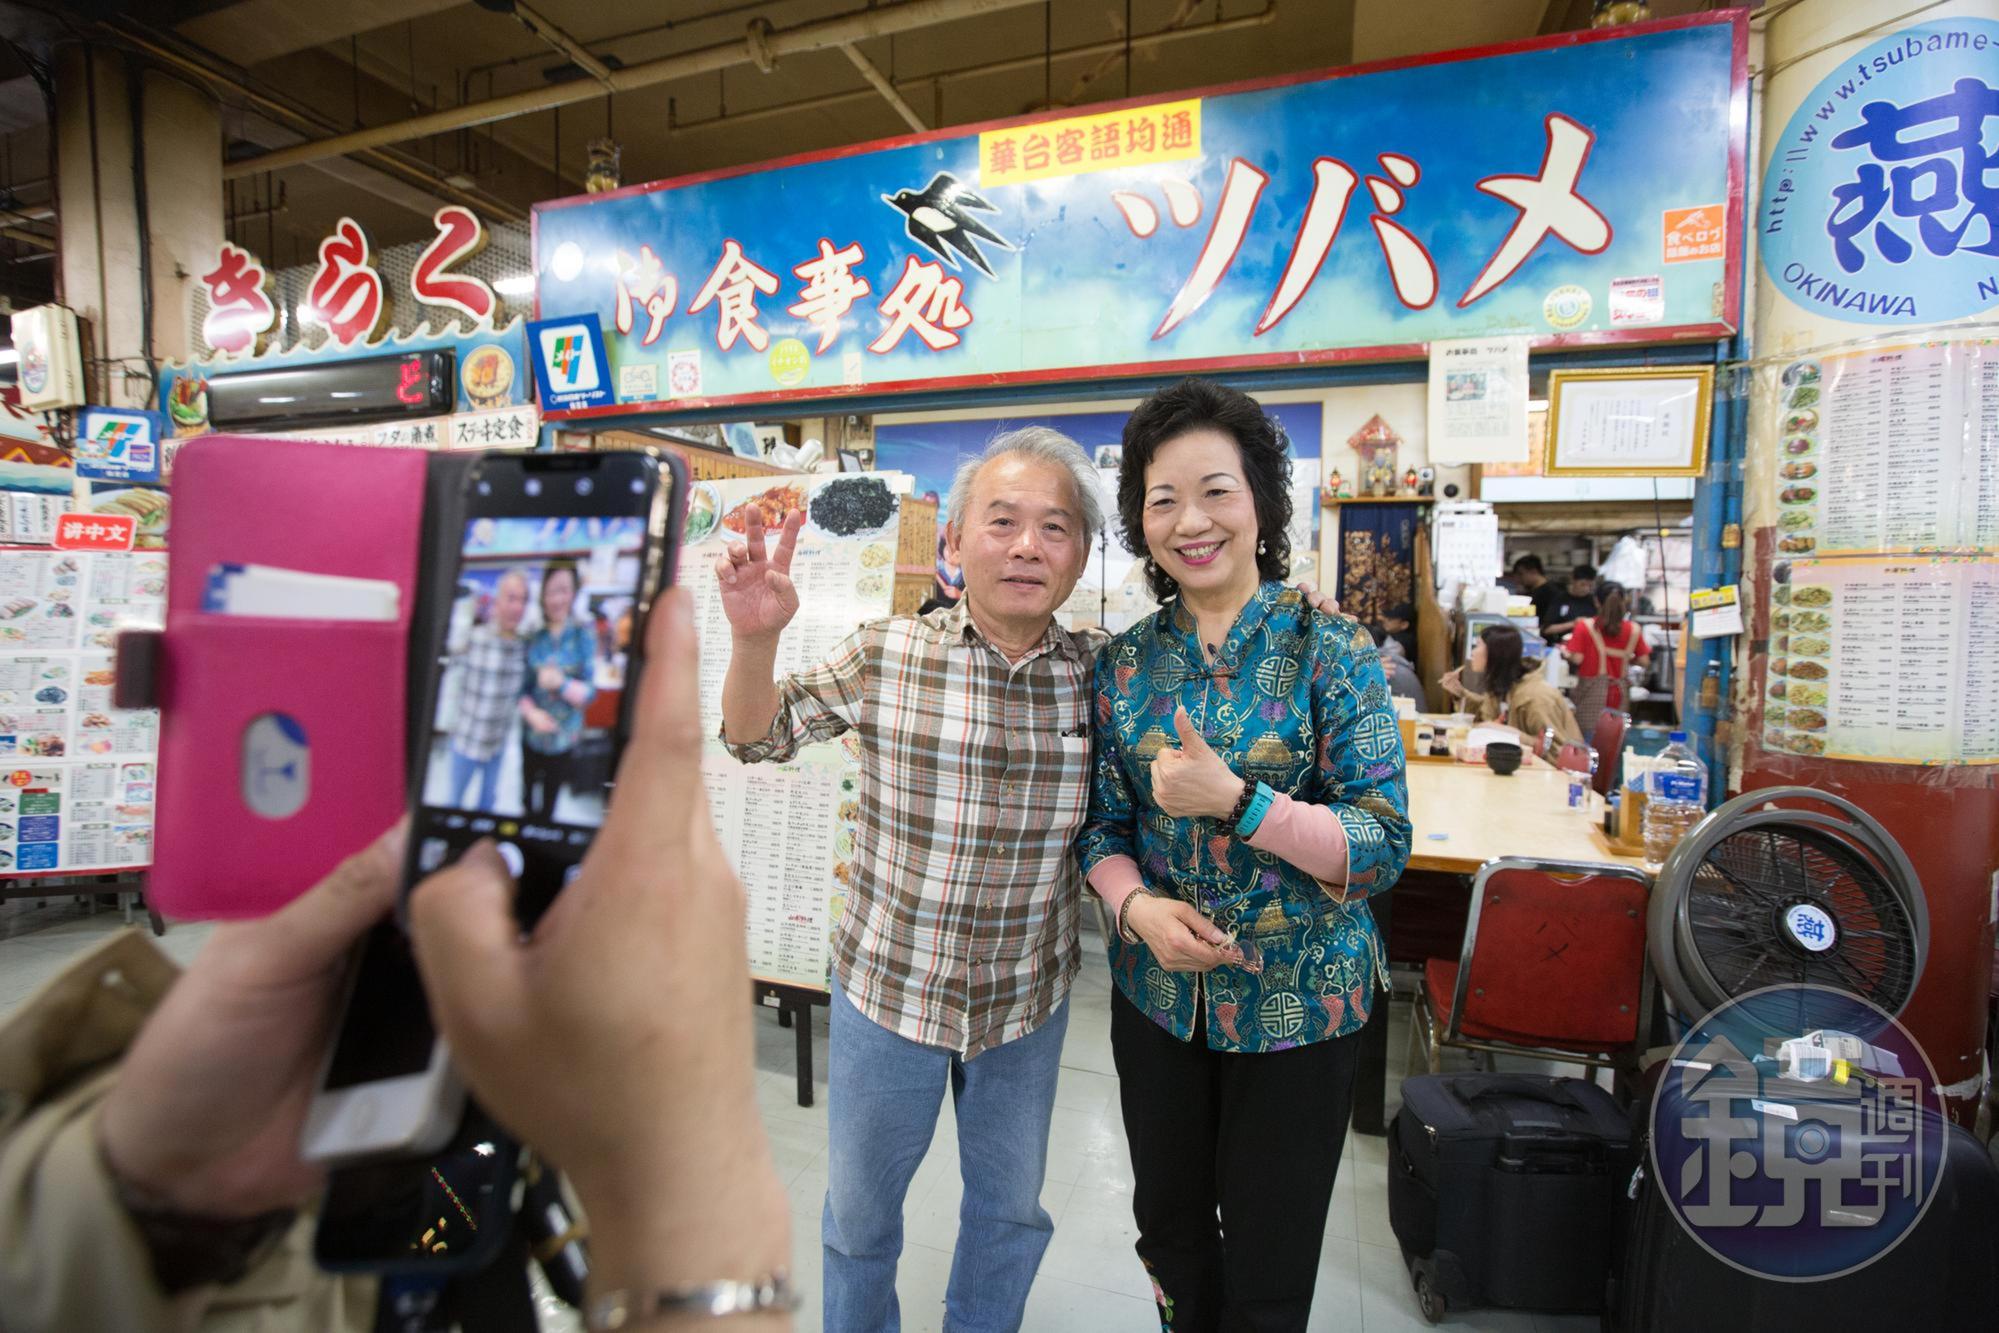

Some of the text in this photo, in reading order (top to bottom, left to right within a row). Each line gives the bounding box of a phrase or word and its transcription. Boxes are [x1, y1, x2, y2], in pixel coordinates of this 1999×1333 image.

[989, 110, 1193, 175] 華台客語均通
[1827, 77, 1999, 274] 燕
[1111, 112, 1613, 340] ツバメ
[1783, 262, 1917, 317] OKINAWA
